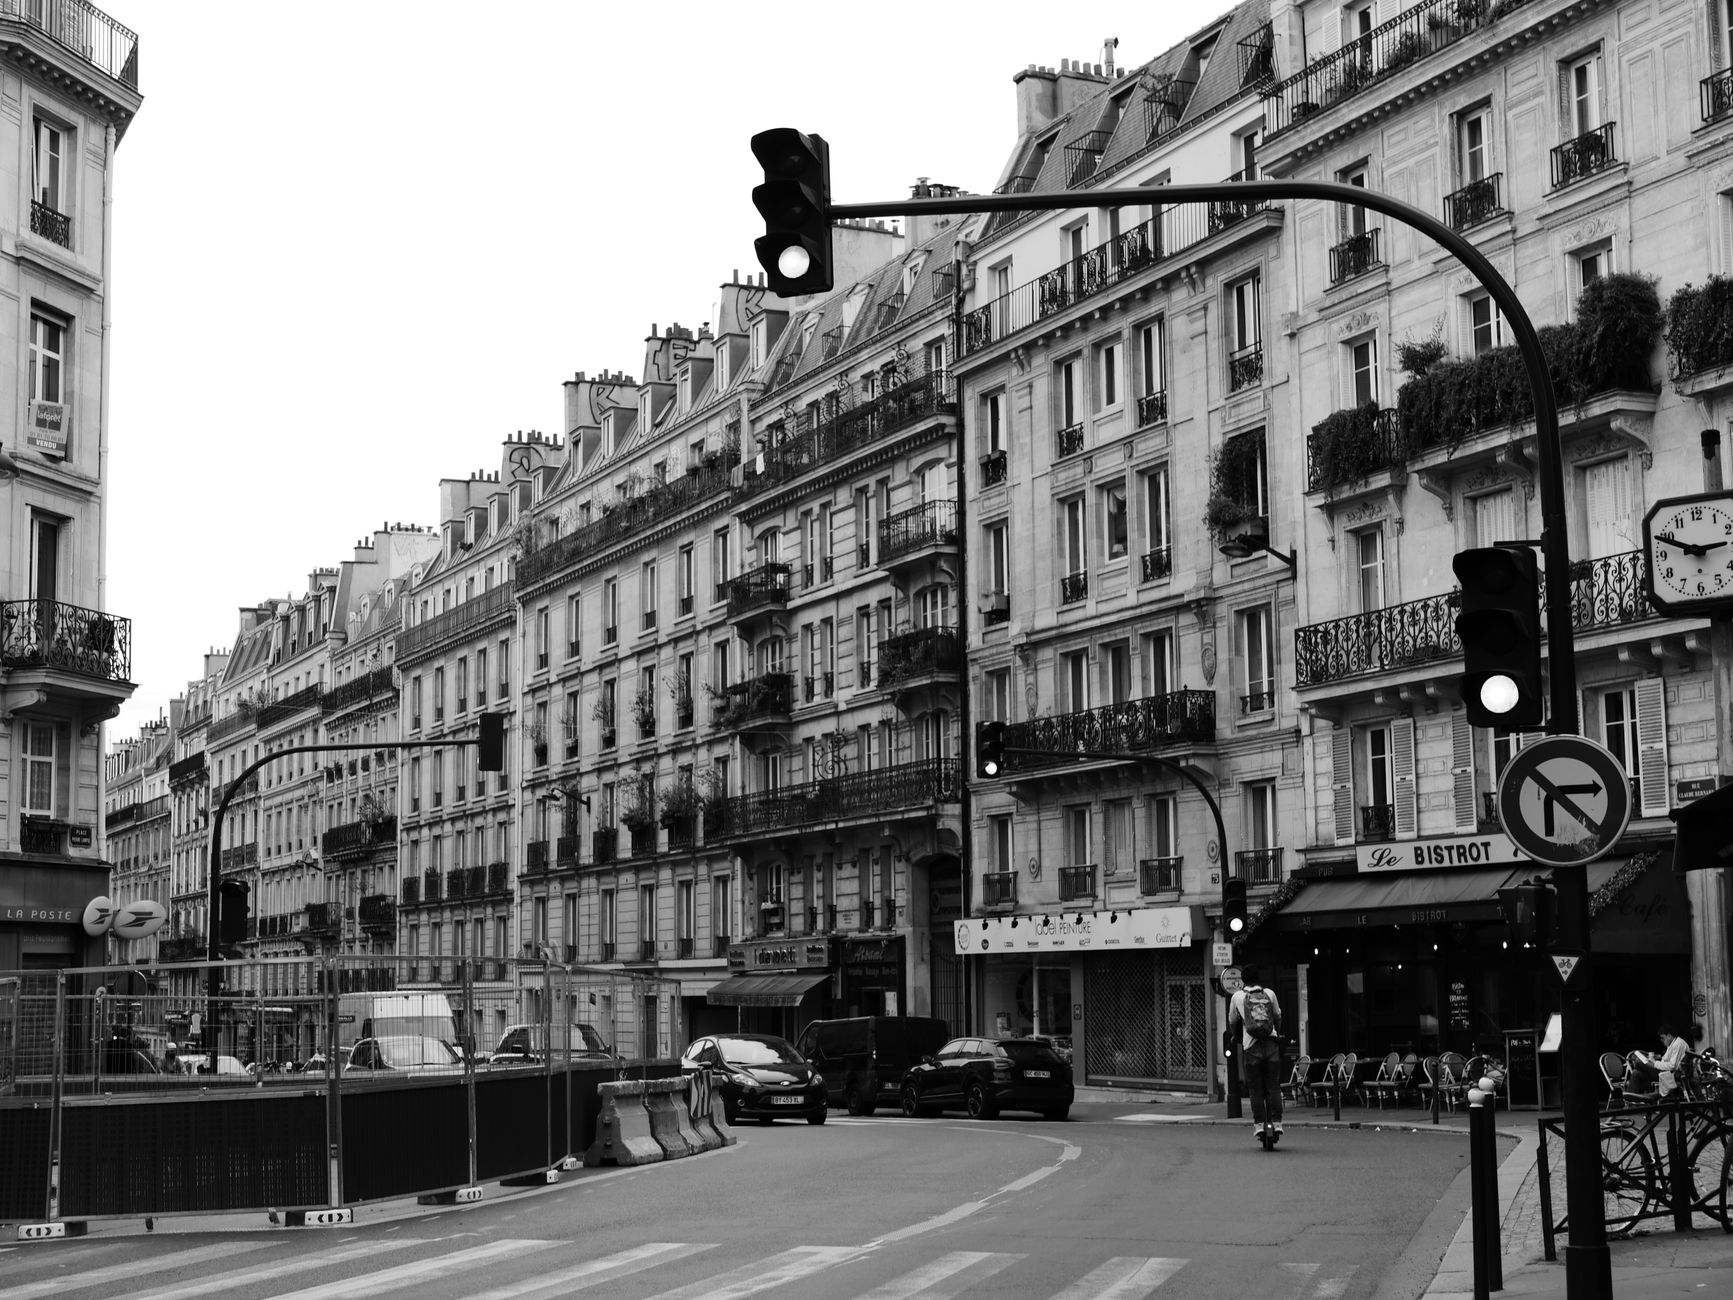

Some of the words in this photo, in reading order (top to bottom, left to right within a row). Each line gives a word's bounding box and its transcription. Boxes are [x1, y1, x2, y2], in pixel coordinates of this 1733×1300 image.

[35, 439, 57, 449] VENDU
[1690, 509, 1703, 521] 12
[1712, 512, 1717, 524] 1
[1674, 517, 1684, 529] 11
[1724, 523, 1732, 535] 2
[1663, 531, 1675, 541] 10
[1659, 550, 1668, 562] 9
[1726, 560, 1733, 571] 4
[1666, 567, 1674, 579] 8
[1680, 578, 1687, 589] 7
[1714, 574, 1722, 586] 5
[1697, 582, 1705, 593] 6
[1678, 791, 1694, 799] CLAUDE
[1367, 847, 1404, 868] Le
[1413, 841, 1491, 865] BISTROT
[1318, 866, 1334, 878] PUB
[7, 909, 24, 919] LA
[31, 909, 73, 921] POSTE
[1357, 914, 1368, 926] LE
[1411, 909, 1448, 922] BISTROT
[1058, 920, 1092, 936] PEINTURE
